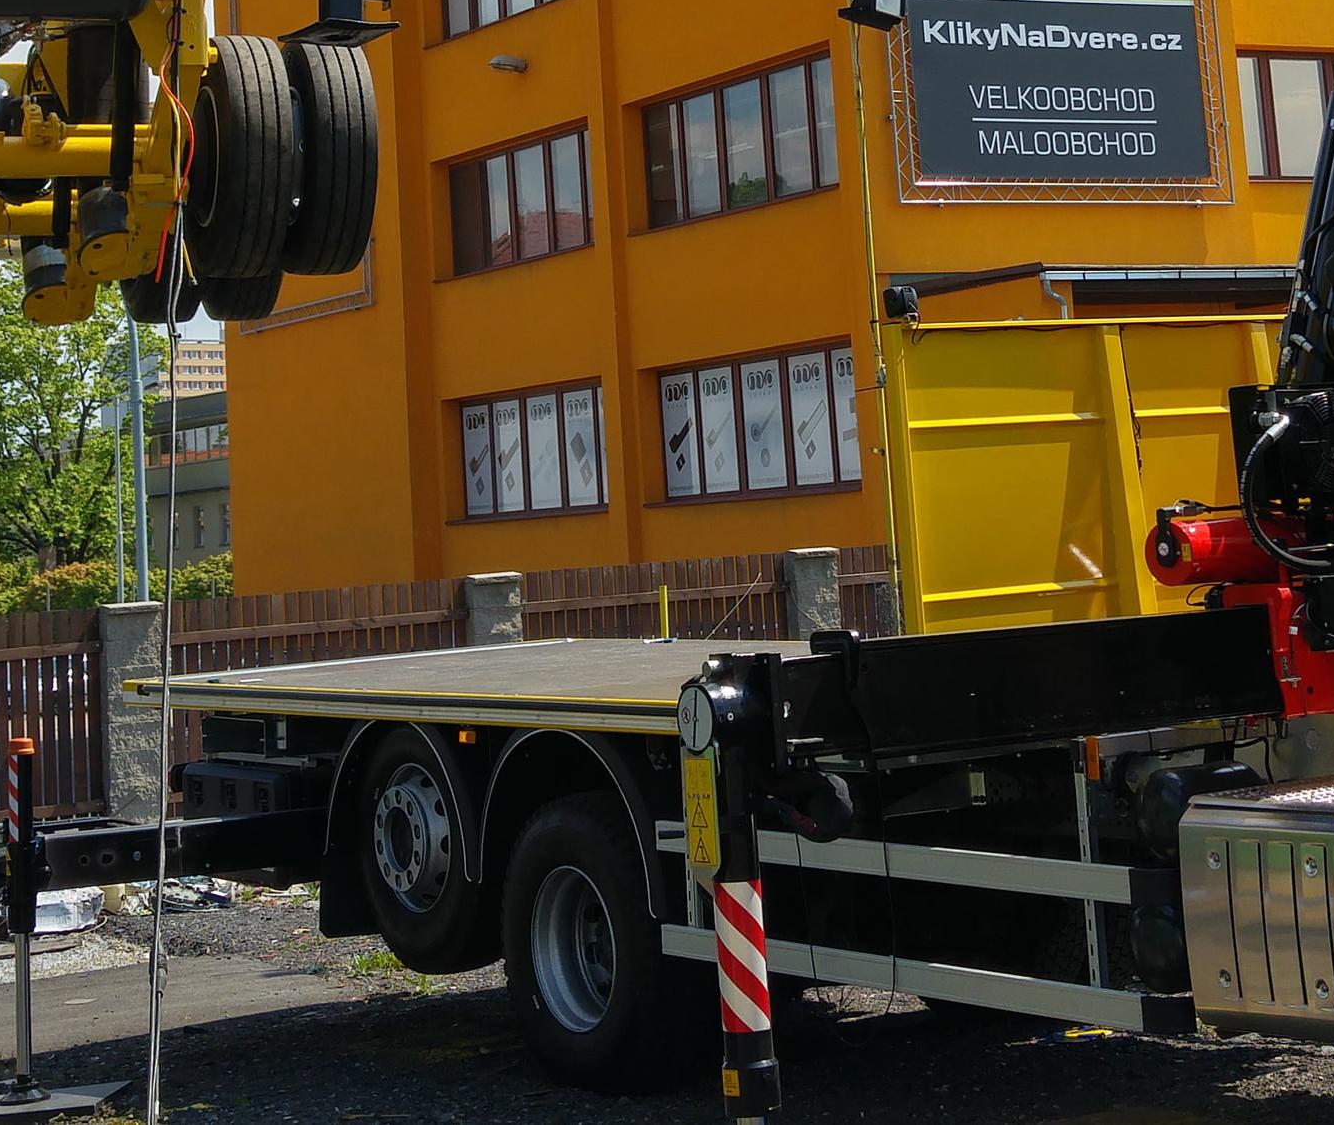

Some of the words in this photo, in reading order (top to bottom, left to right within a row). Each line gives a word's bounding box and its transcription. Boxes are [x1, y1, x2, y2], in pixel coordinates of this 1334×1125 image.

[922, 19, 1183, 51] KlikyNaDvere.cz
[969, 84, 1156, 112] VELKOOBCHOD
[978, 130, 1157, 156] MALOOBCHOD
